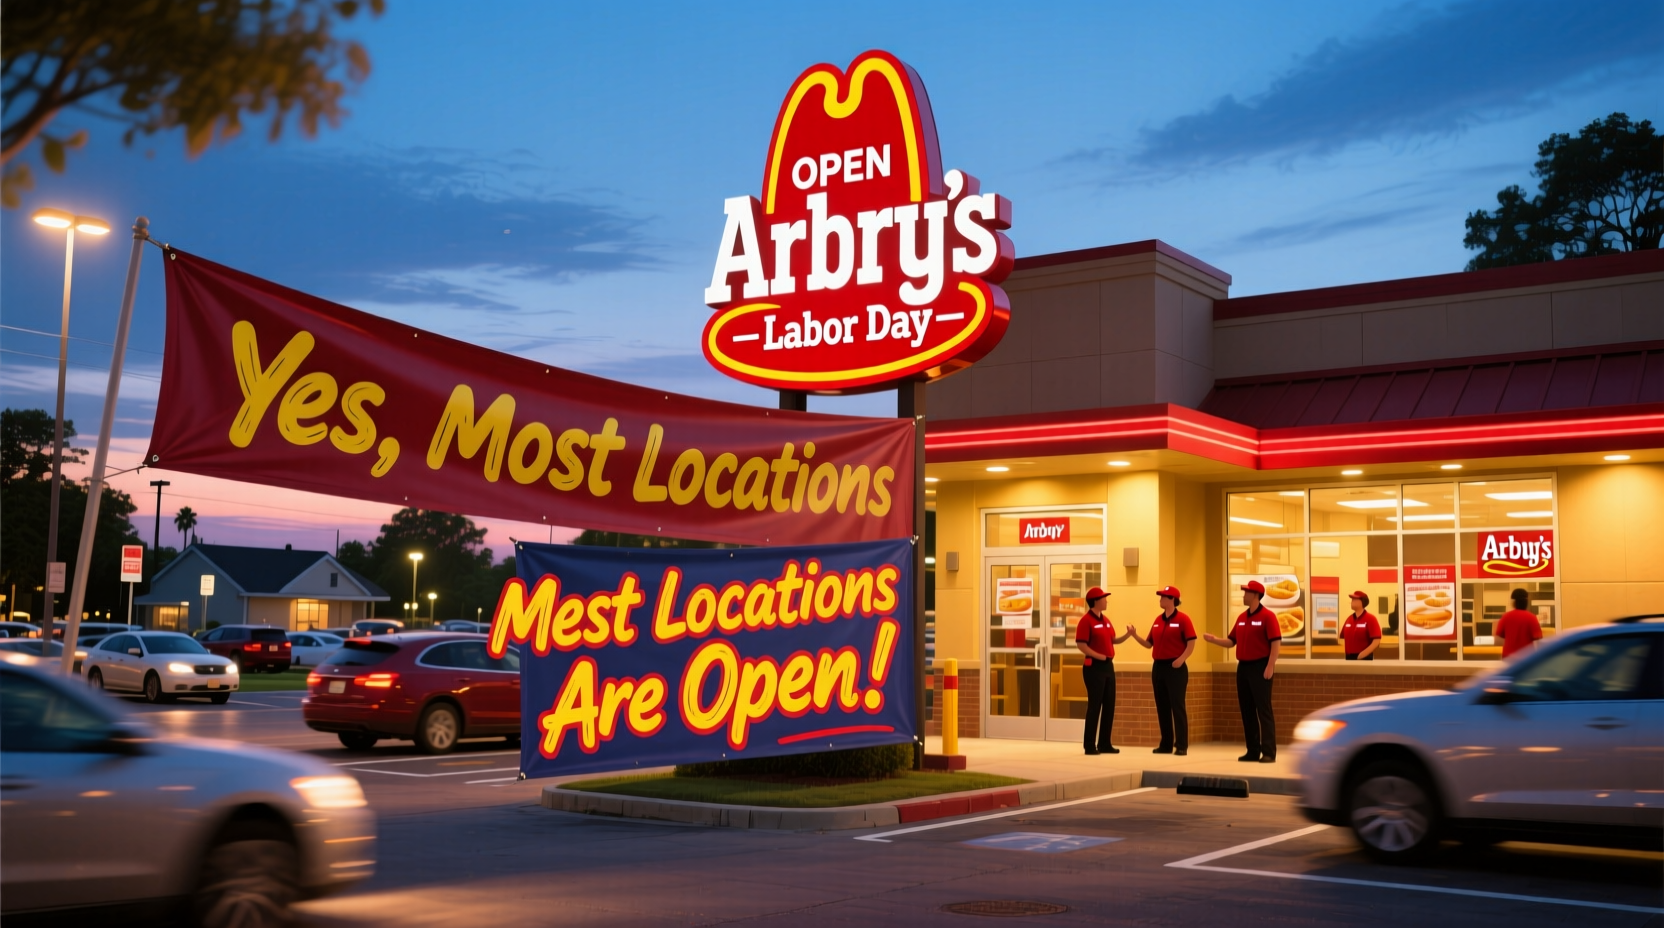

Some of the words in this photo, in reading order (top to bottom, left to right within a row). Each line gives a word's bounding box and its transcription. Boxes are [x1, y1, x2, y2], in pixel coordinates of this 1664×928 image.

[792, 144, 891, 190] OPEN
[704, 168, 997, 306] Arbry's
[763, 310, 859, 351] Labor
[866, 304, 933, 348] Day
[229, 320, 400, 478] Yes,
[426, 384, 626, 497] Most
[632, 423, 894, 516] Locations
[490, 570, 642, 656] Mest
[653, 561, 899, 641] Locations
[541, 660, 665, 755] Are
[682, 620, 898, 747] Open!
